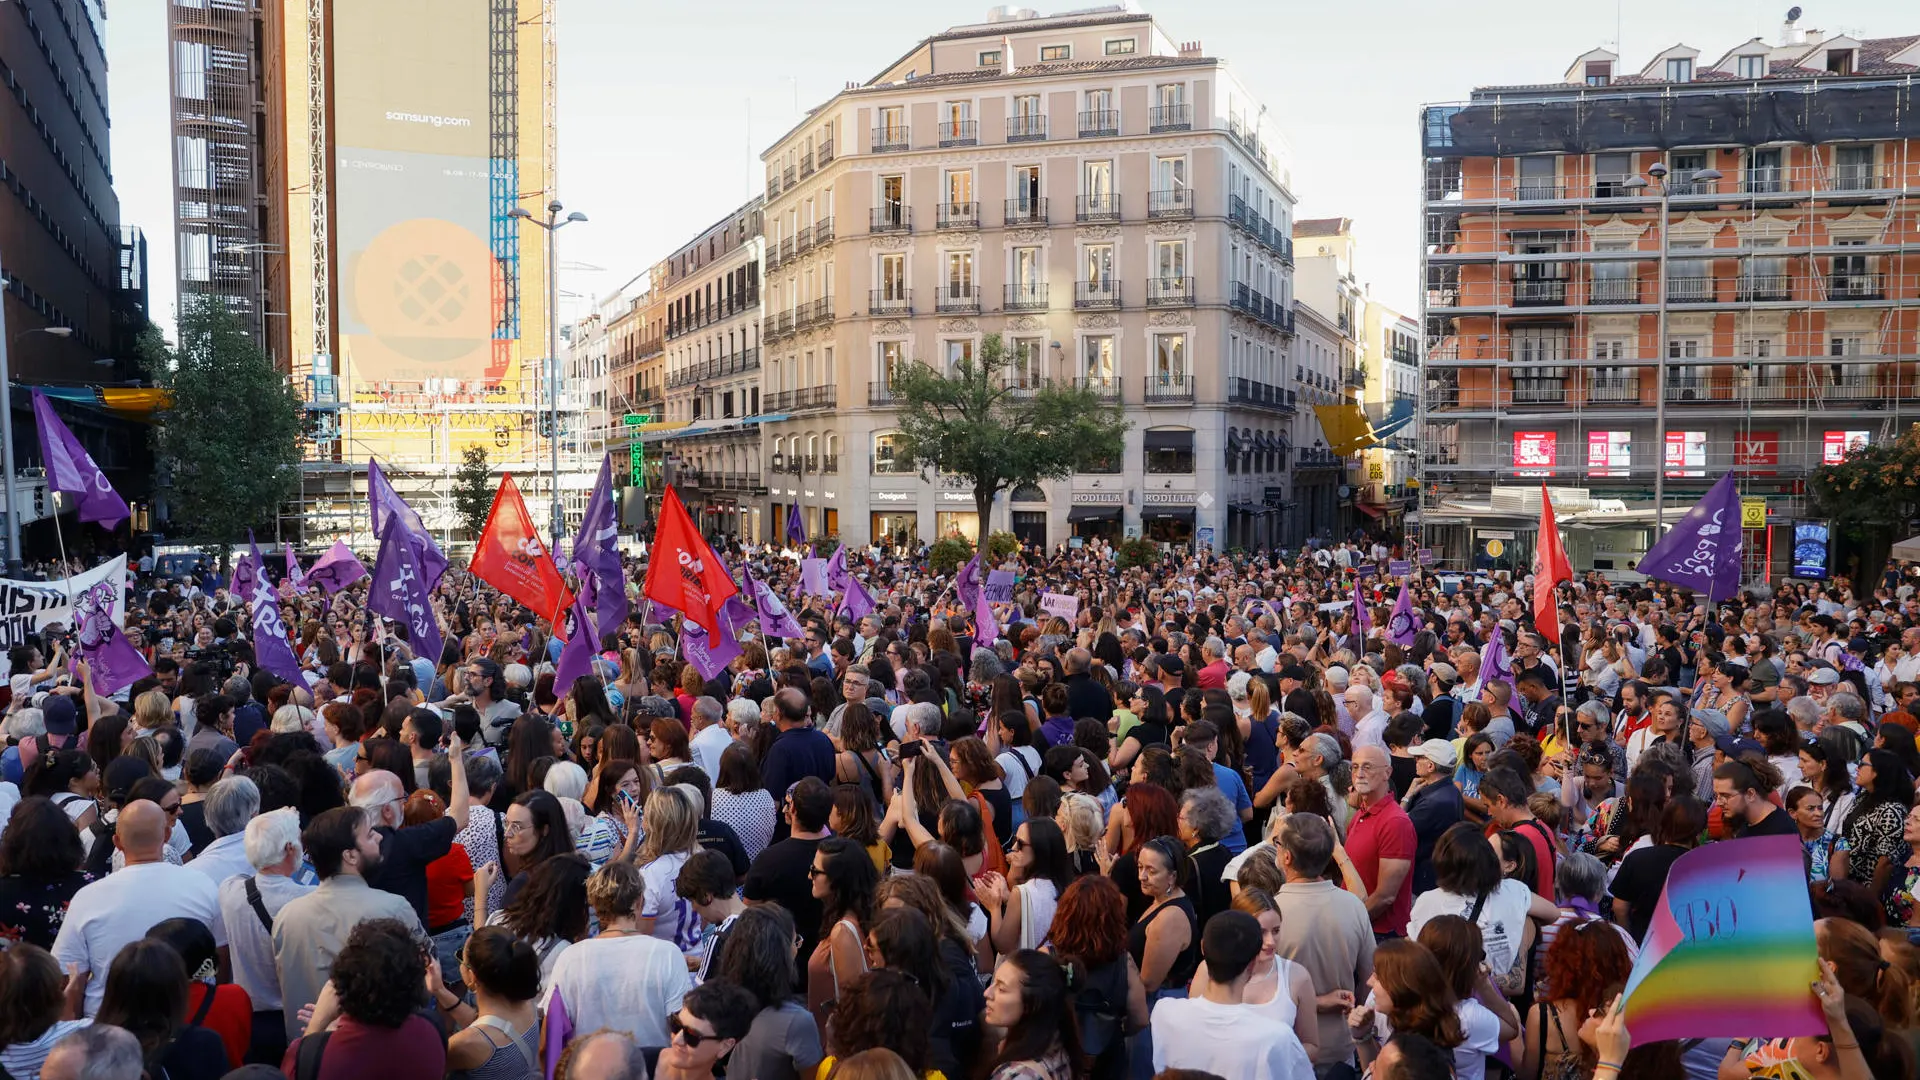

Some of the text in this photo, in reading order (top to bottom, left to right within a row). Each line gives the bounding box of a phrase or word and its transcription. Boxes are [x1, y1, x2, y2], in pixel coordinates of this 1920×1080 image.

[386, 110, 471, 127] samsung.com
[1370, 463, 1381, 471] DIS
[1370, 471, 1383, 479] COS
[1074, 493, 1121, 502] RODILLA
[1145, 493, 1193, 502] RODILLA
